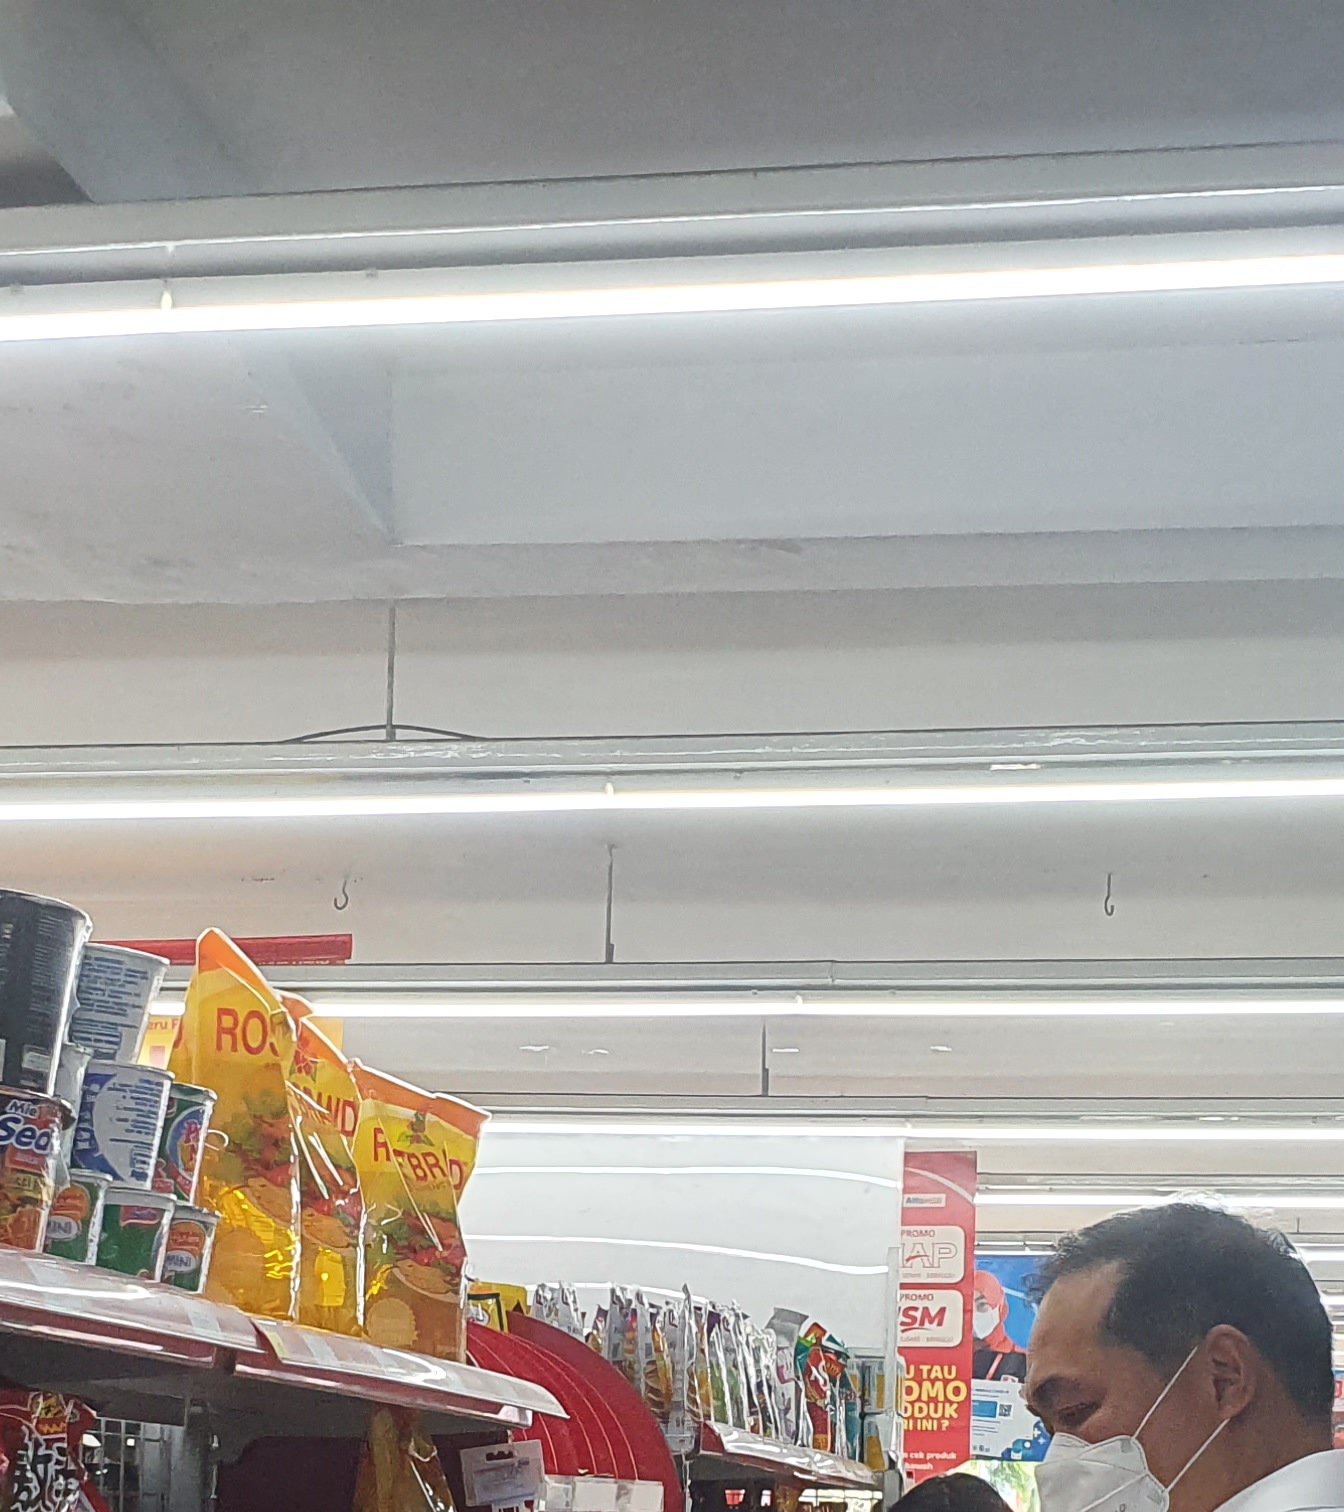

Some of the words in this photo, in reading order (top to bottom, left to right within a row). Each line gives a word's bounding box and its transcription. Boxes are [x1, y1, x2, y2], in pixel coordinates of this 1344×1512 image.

[6, 1100, 38, 1118] Mie
[901, 1229, 936, 1238] PROMO
[920, 1364, 957, 1380] TAU
[917, 1418, 938, 1431] INI
